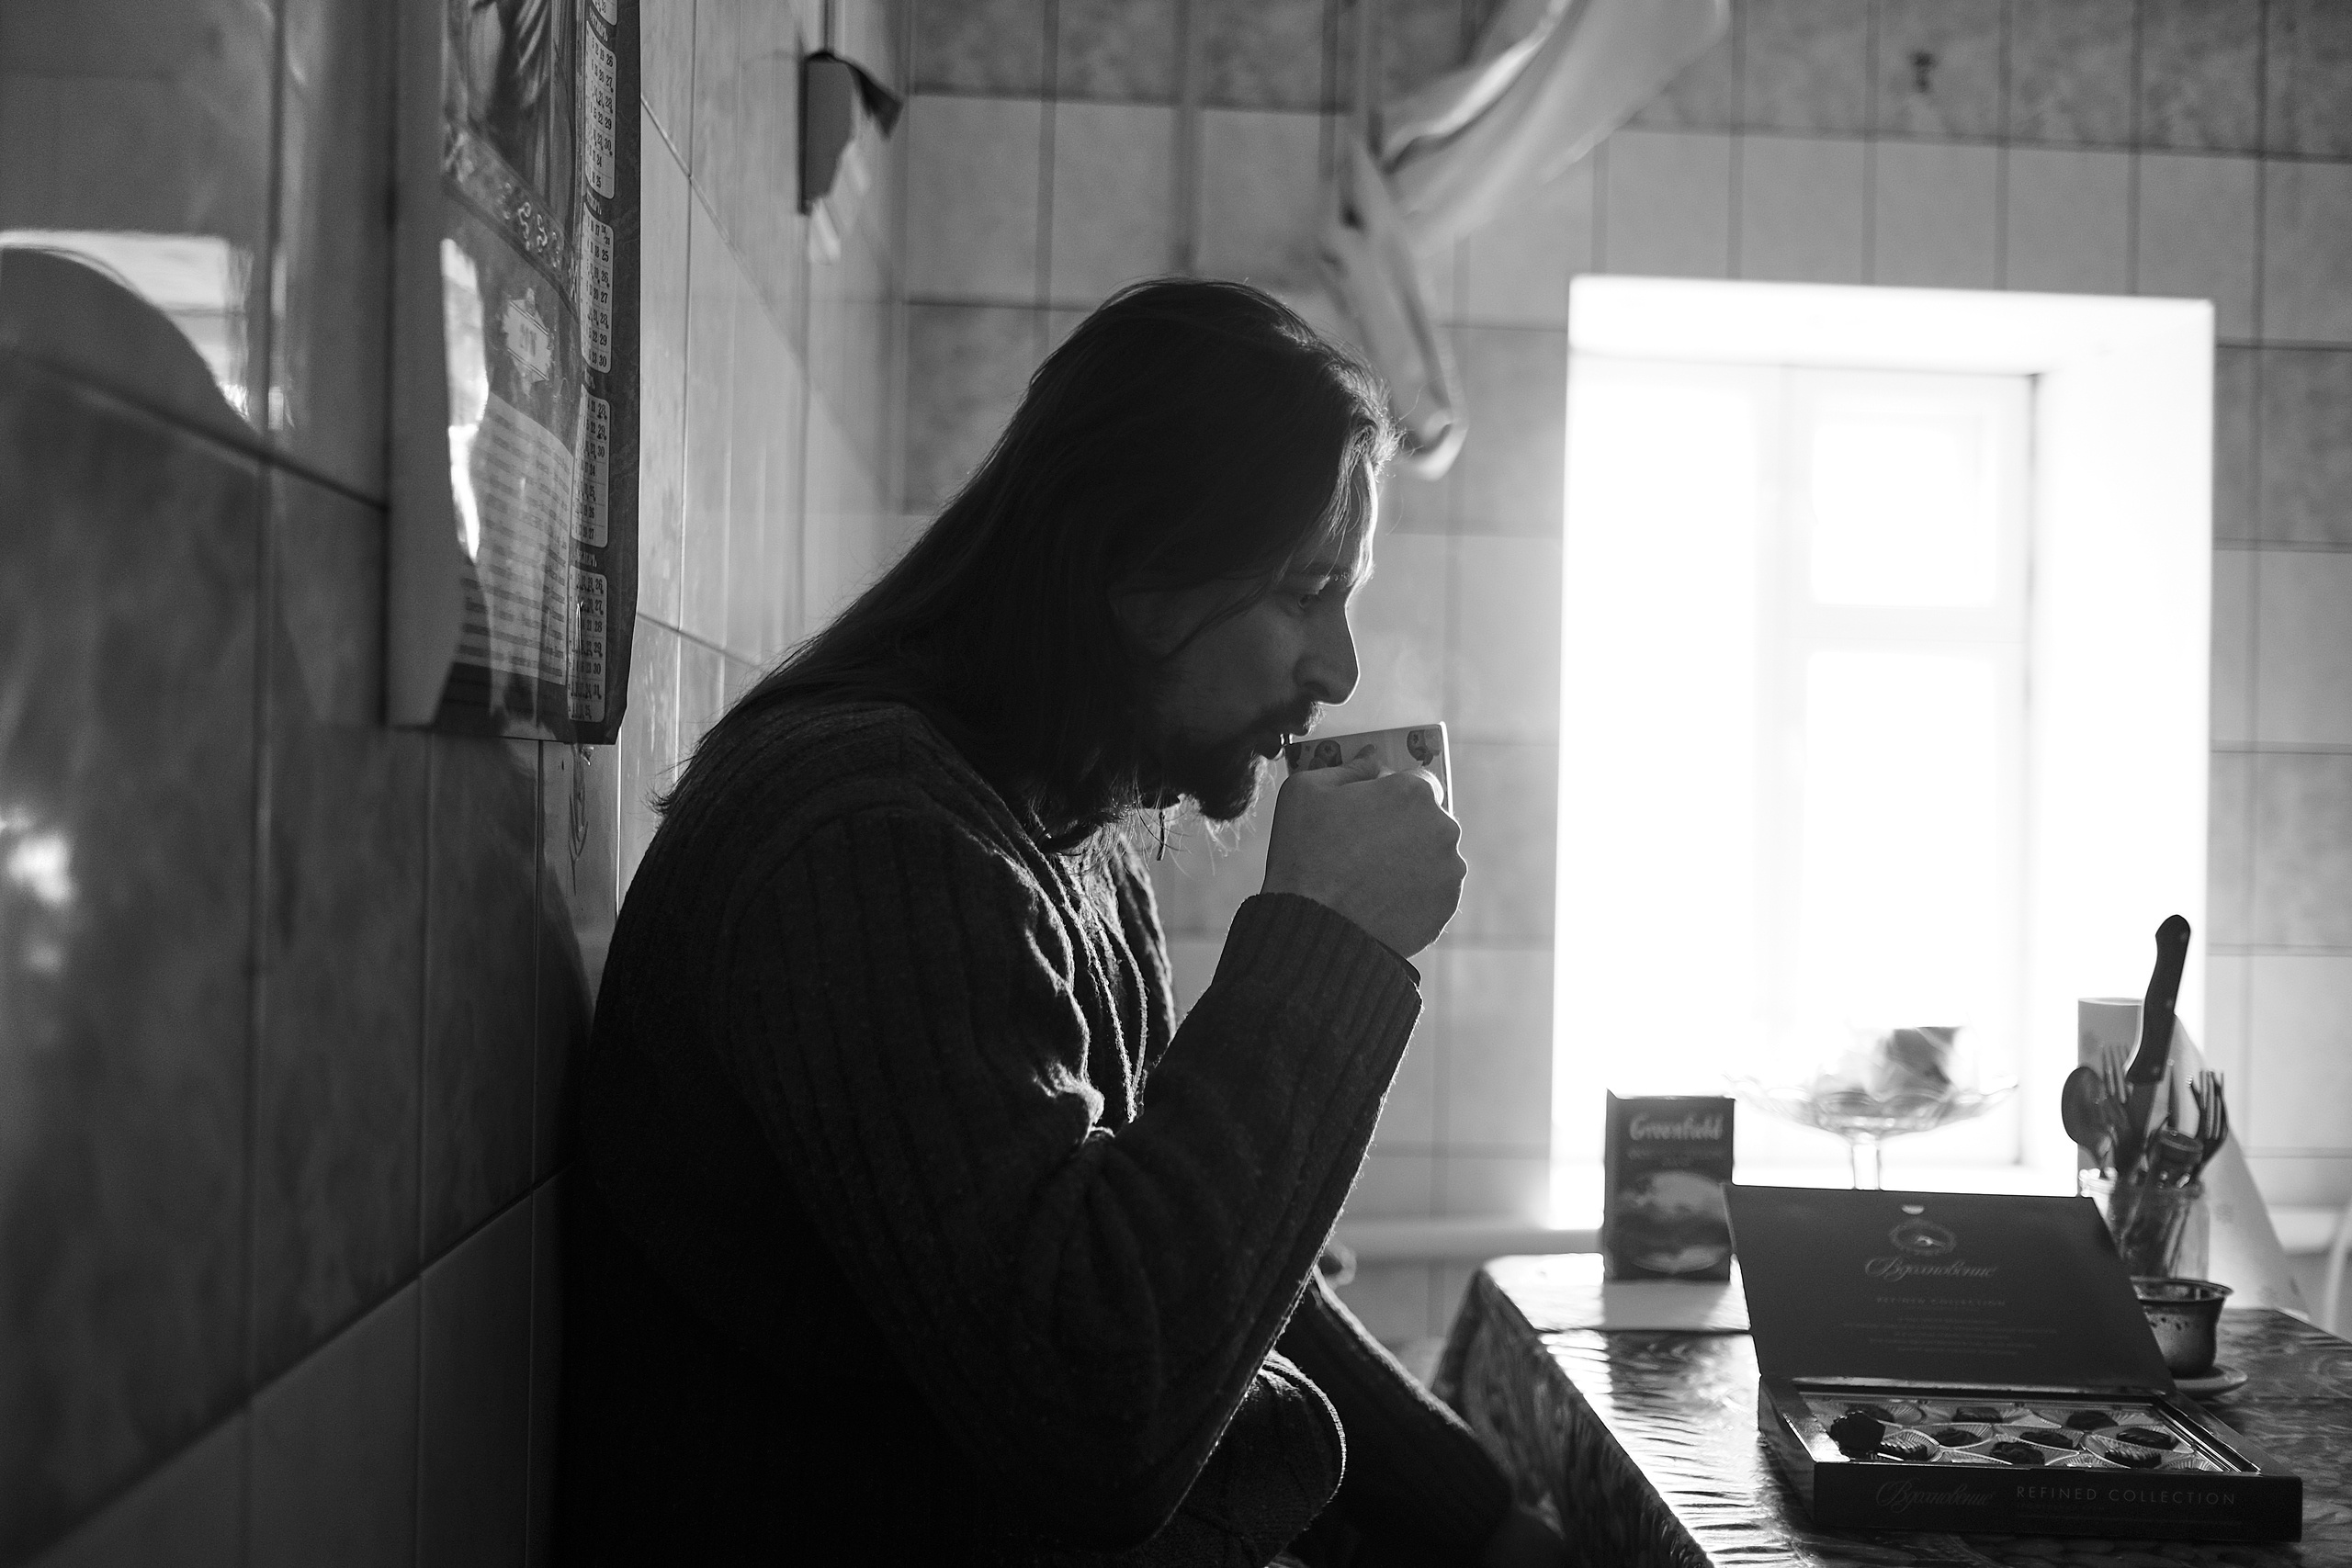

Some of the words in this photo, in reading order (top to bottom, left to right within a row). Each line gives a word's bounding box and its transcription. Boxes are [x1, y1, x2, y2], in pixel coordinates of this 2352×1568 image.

[1630, 1112, 1724, 1140] Greenfield
[1876, 1477, 1994, 1514] Вдохновение
[2017, 1485, 2098, 1501] REFINED
[2109, 1488, 2235, 1505] COLLECTION
